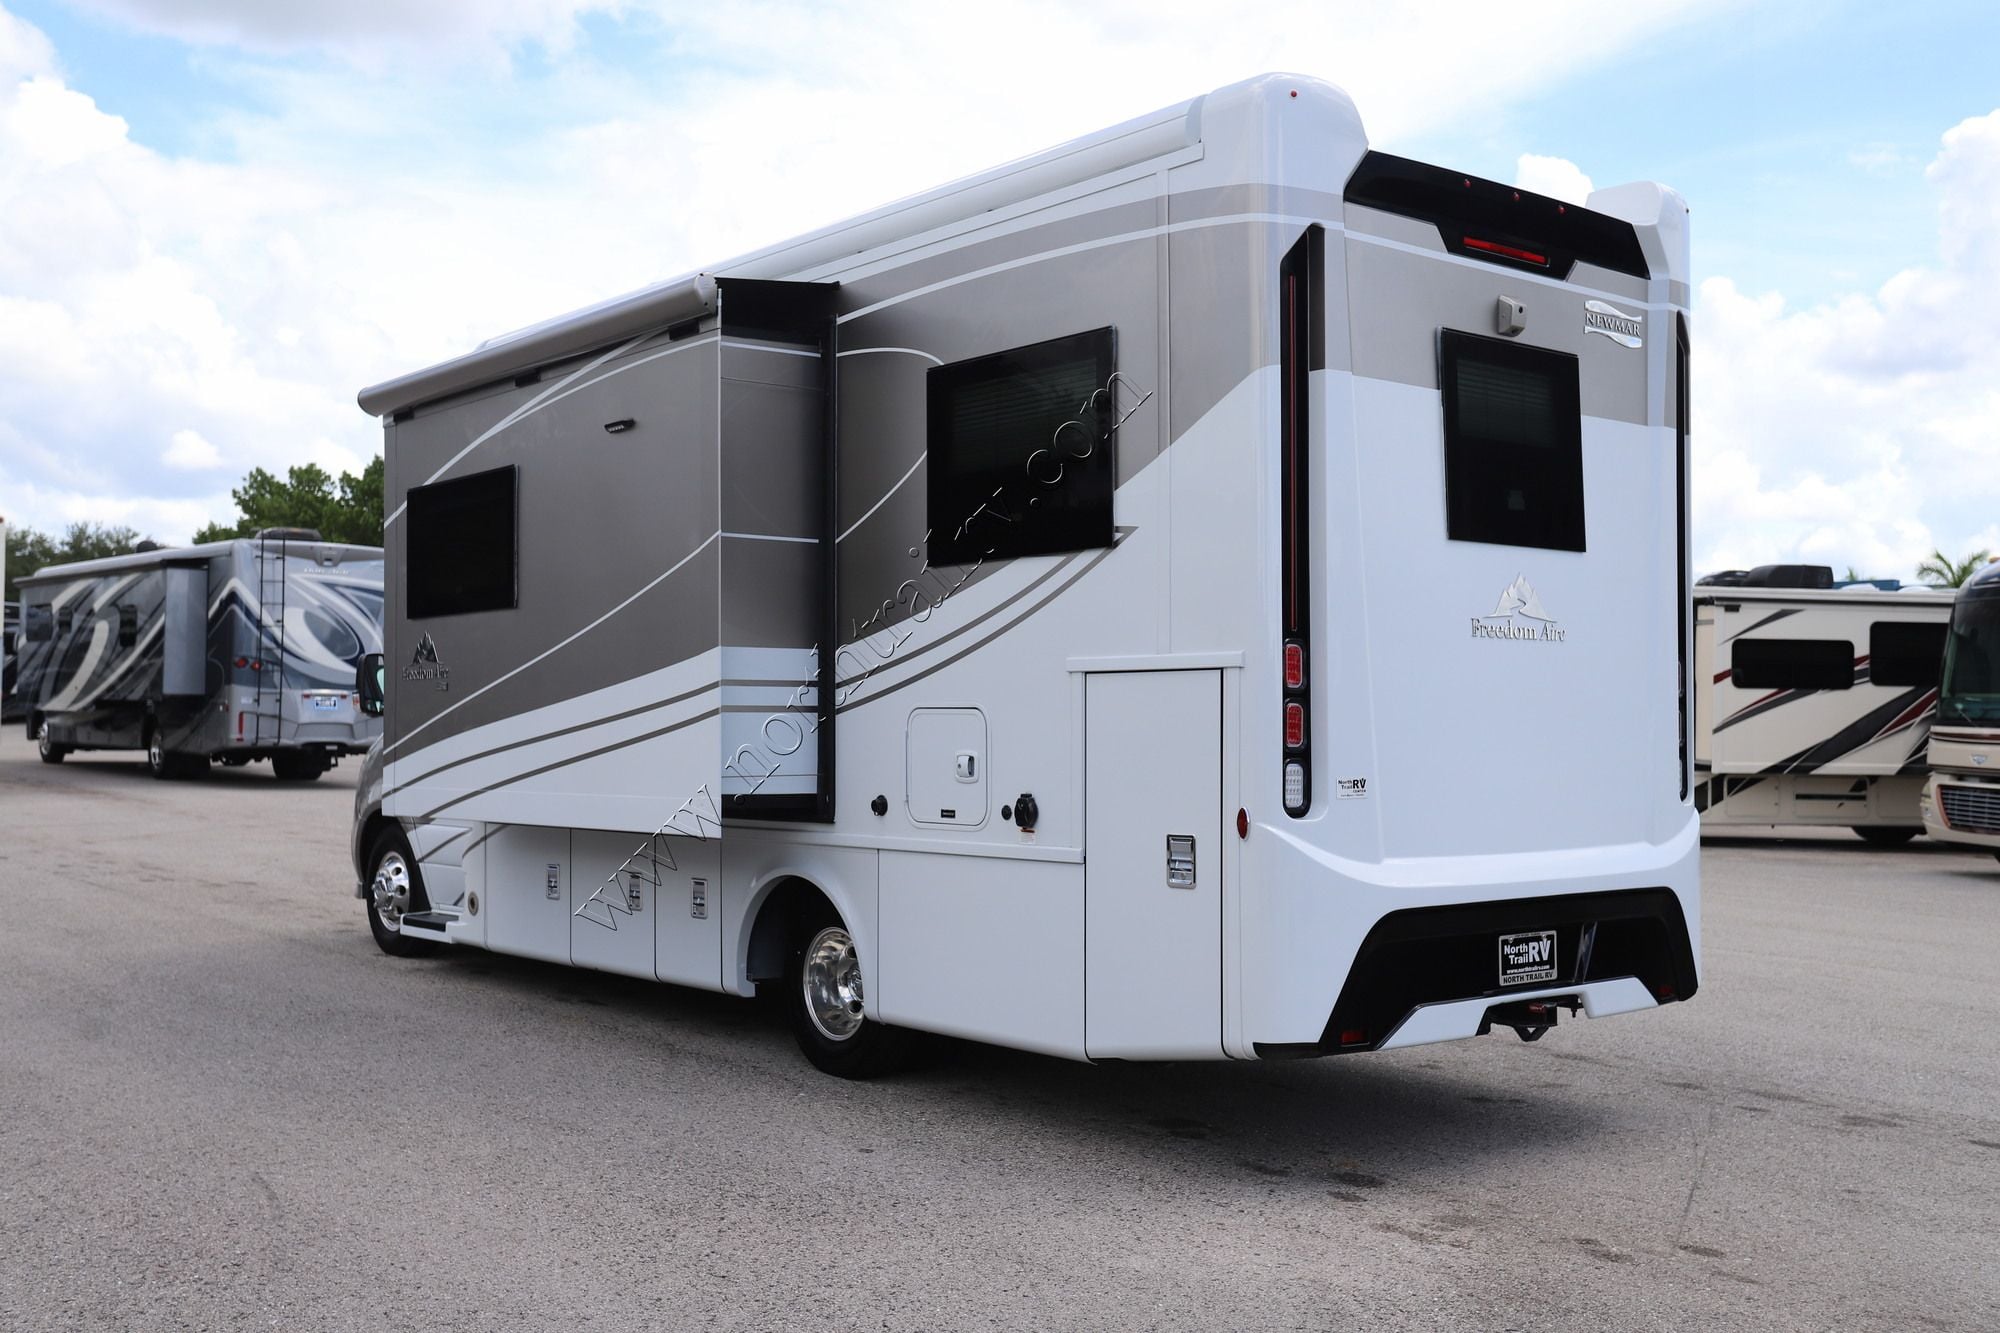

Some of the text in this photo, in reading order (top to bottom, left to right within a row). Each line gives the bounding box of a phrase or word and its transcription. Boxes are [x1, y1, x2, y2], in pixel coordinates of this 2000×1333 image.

[1585, 312, 1641, 337] NEWMAR
[1470, 617, 1566, 642] Freedom Aire
[1352, 778, 1366, 789] RV
[1504, 938, 1551, 963] North RV
[1508, 953, 1528, 965] Trail
[1503, 971, 1553, 984] NORTH TRAIL RV
